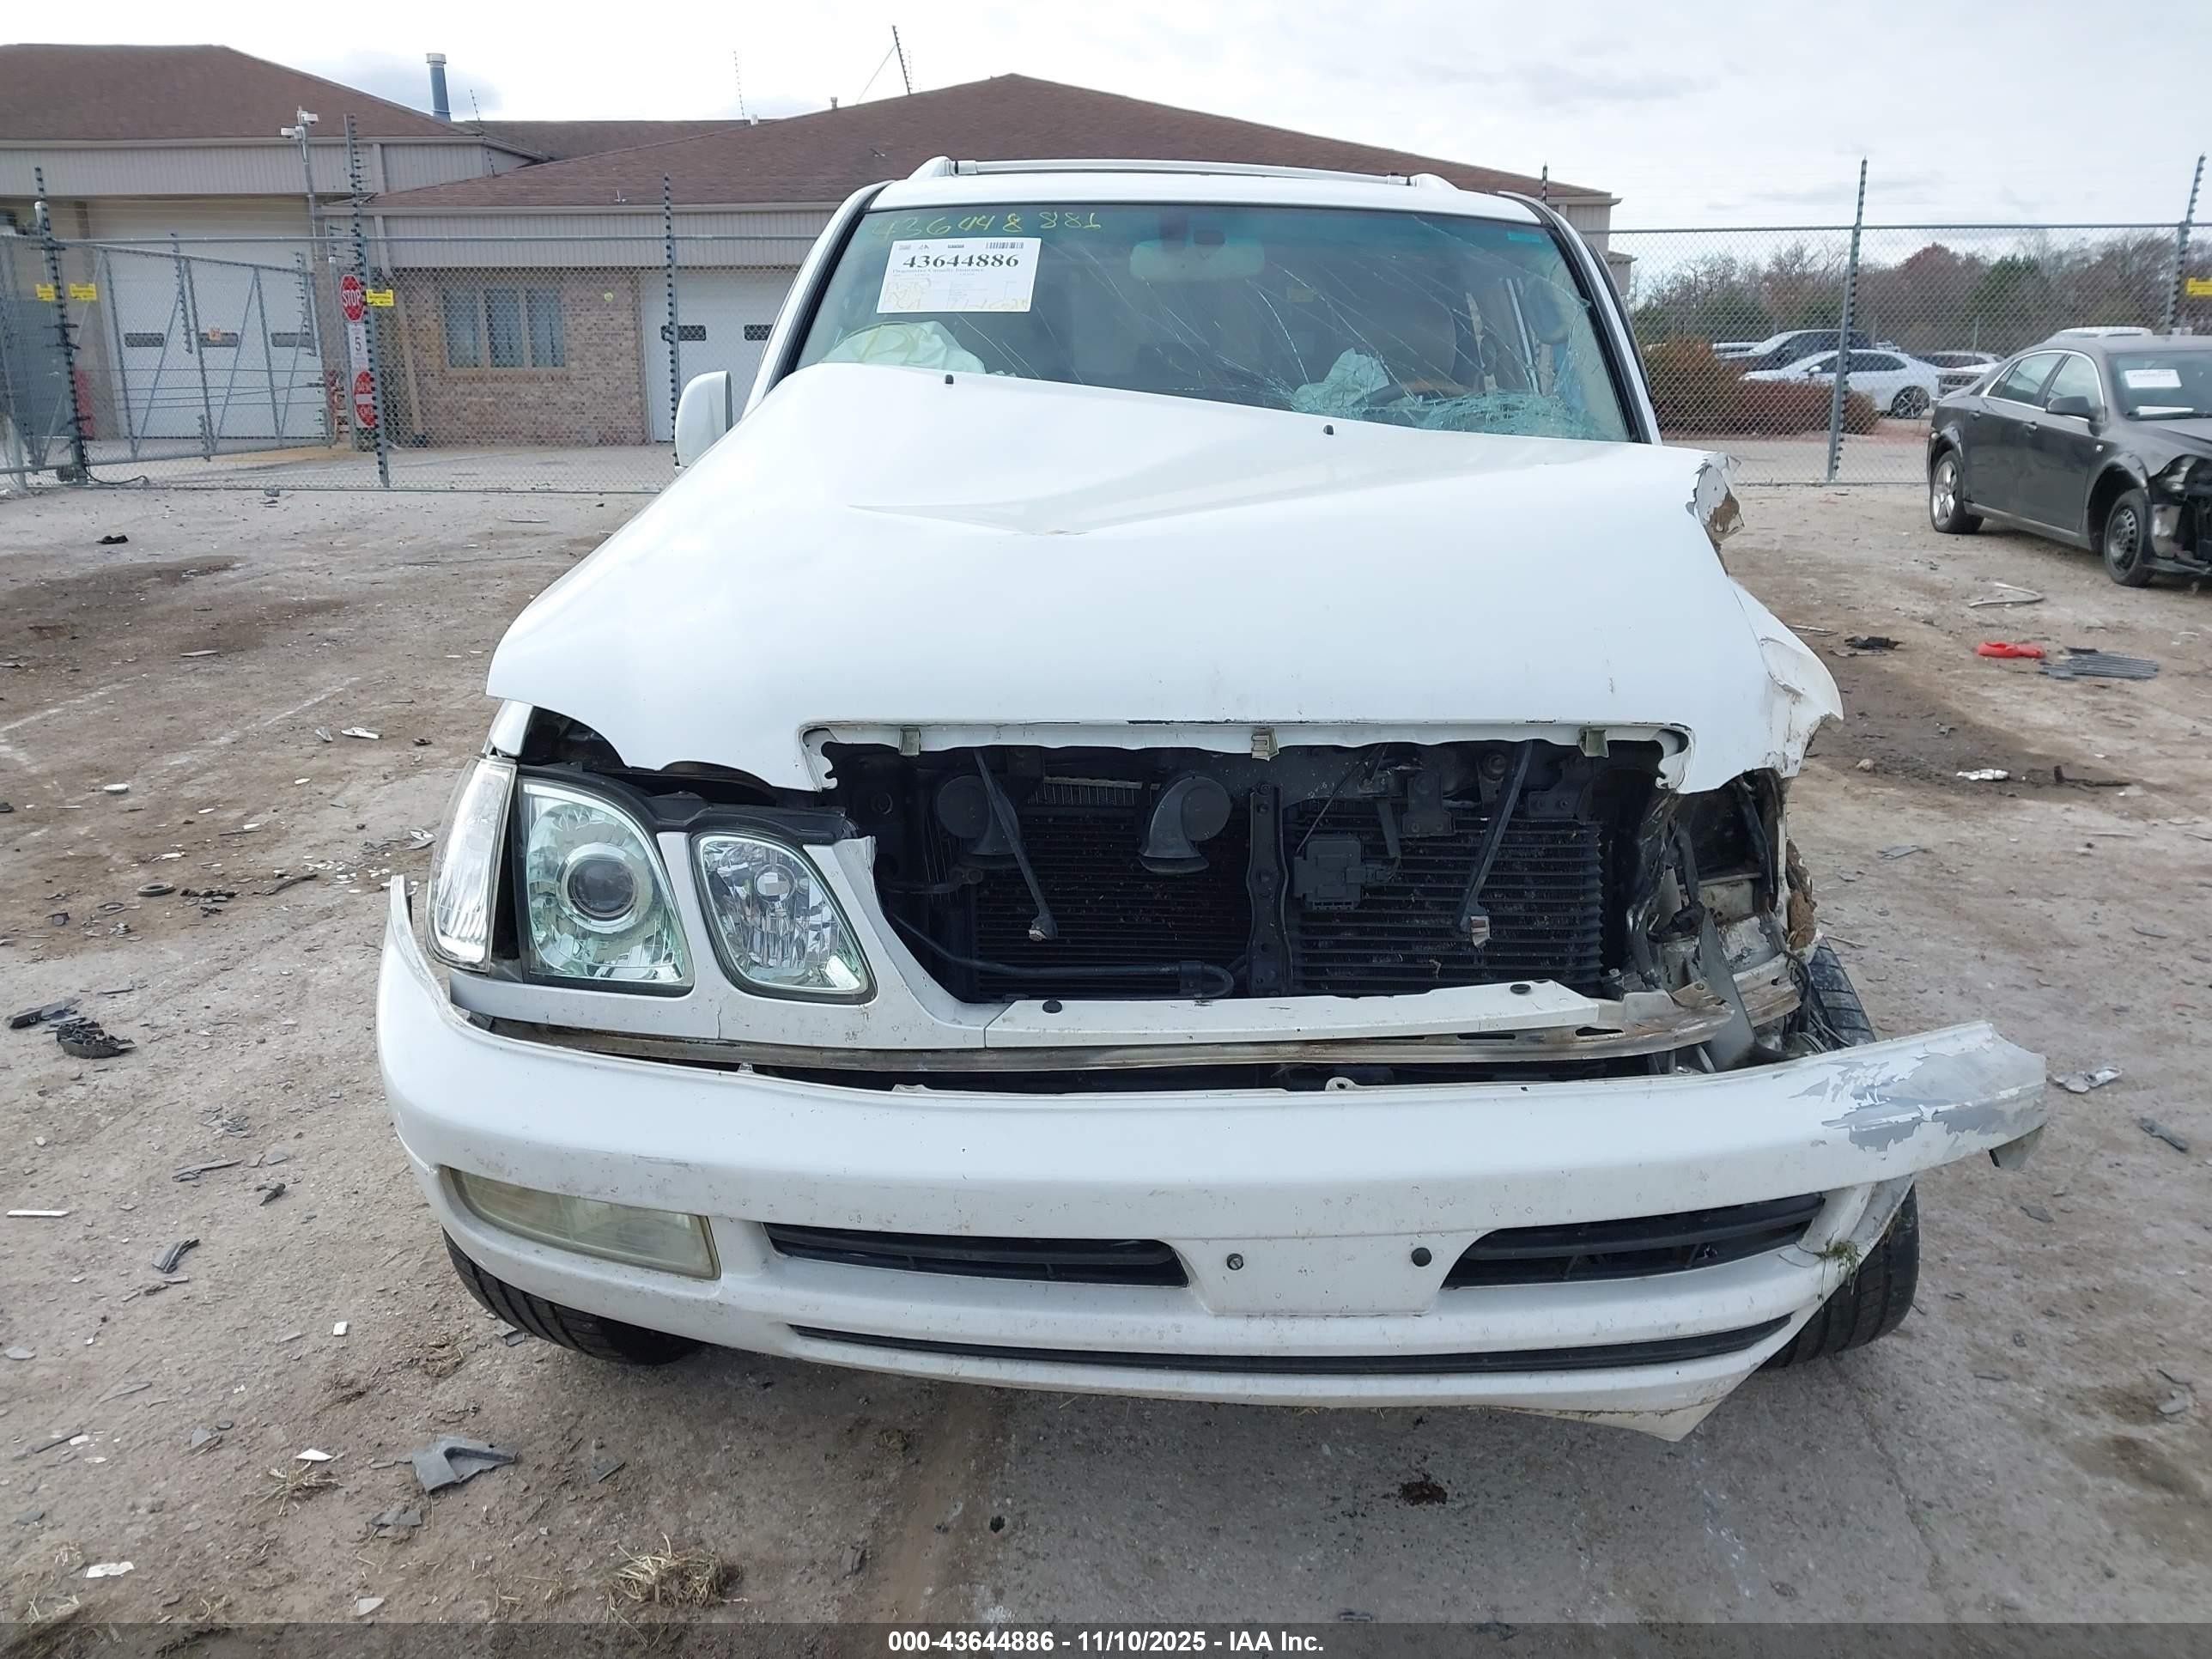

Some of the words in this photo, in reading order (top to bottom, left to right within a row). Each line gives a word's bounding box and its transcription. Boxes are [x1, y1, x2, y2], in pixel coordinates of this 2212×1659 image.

[902, 252, 1020, 268] 43644886
[342, 289, 362, 307] STOP
[355, 336, 362, 351] 5
